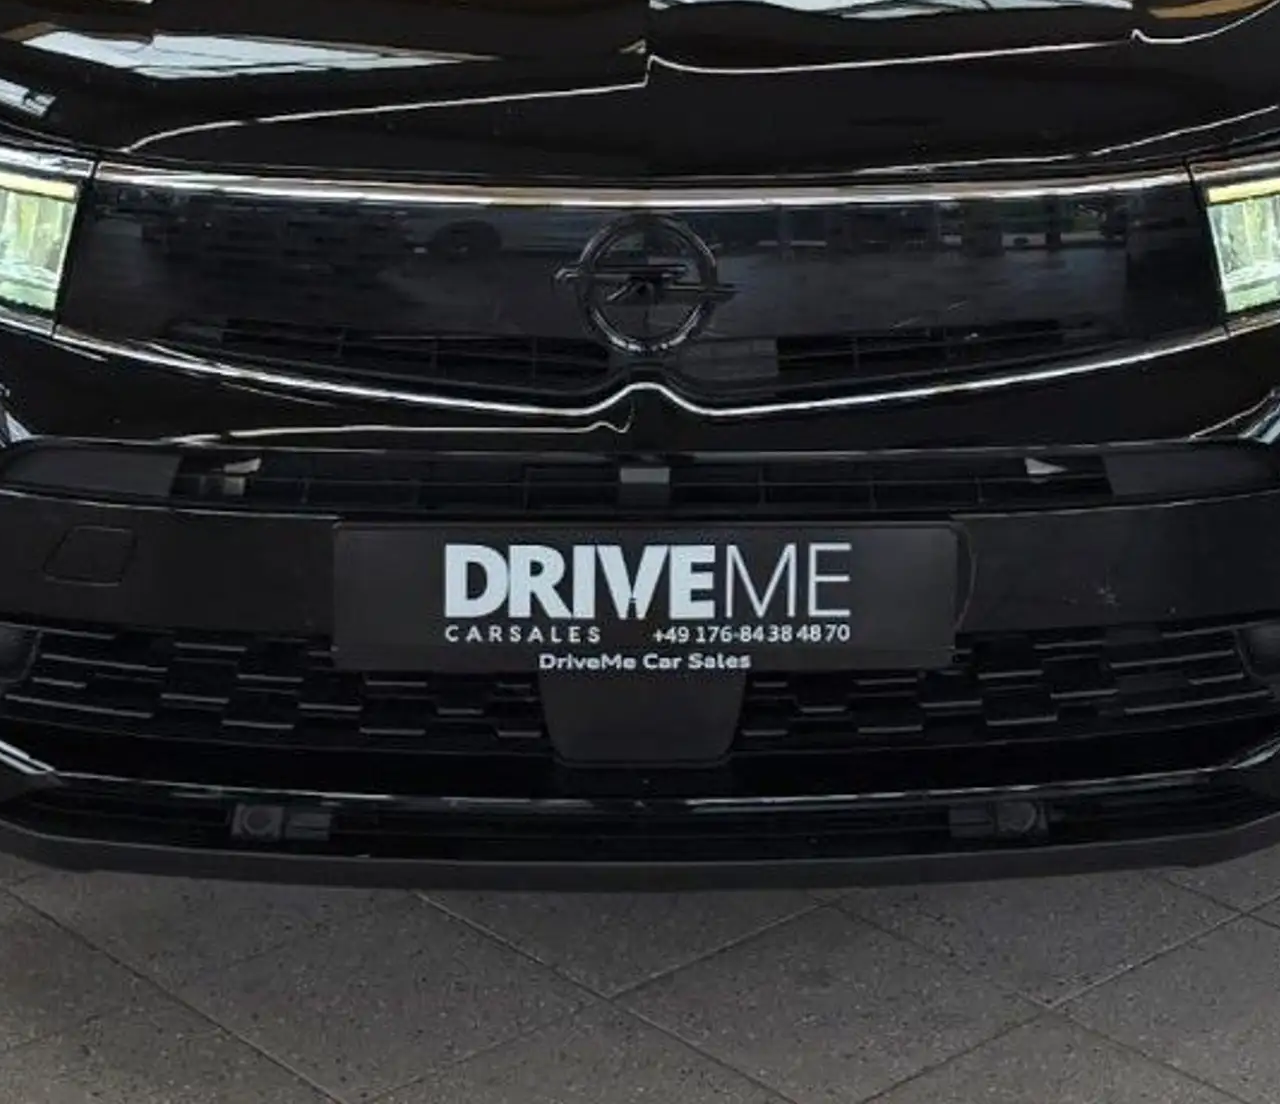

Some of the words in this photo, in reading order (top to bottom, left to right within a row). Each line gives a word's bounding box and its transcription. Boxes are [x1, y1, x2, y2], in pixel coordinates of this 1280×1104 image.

[444, 542, 852, 620] DRIVEME
[444, 624, 602, 643] CARSALES
[653, 625, 690, 644] +49
[538, 652, 637, 670] DriveMe
[642, 652, 682, 669] Car
[687, 652, 752, 669] Sales
